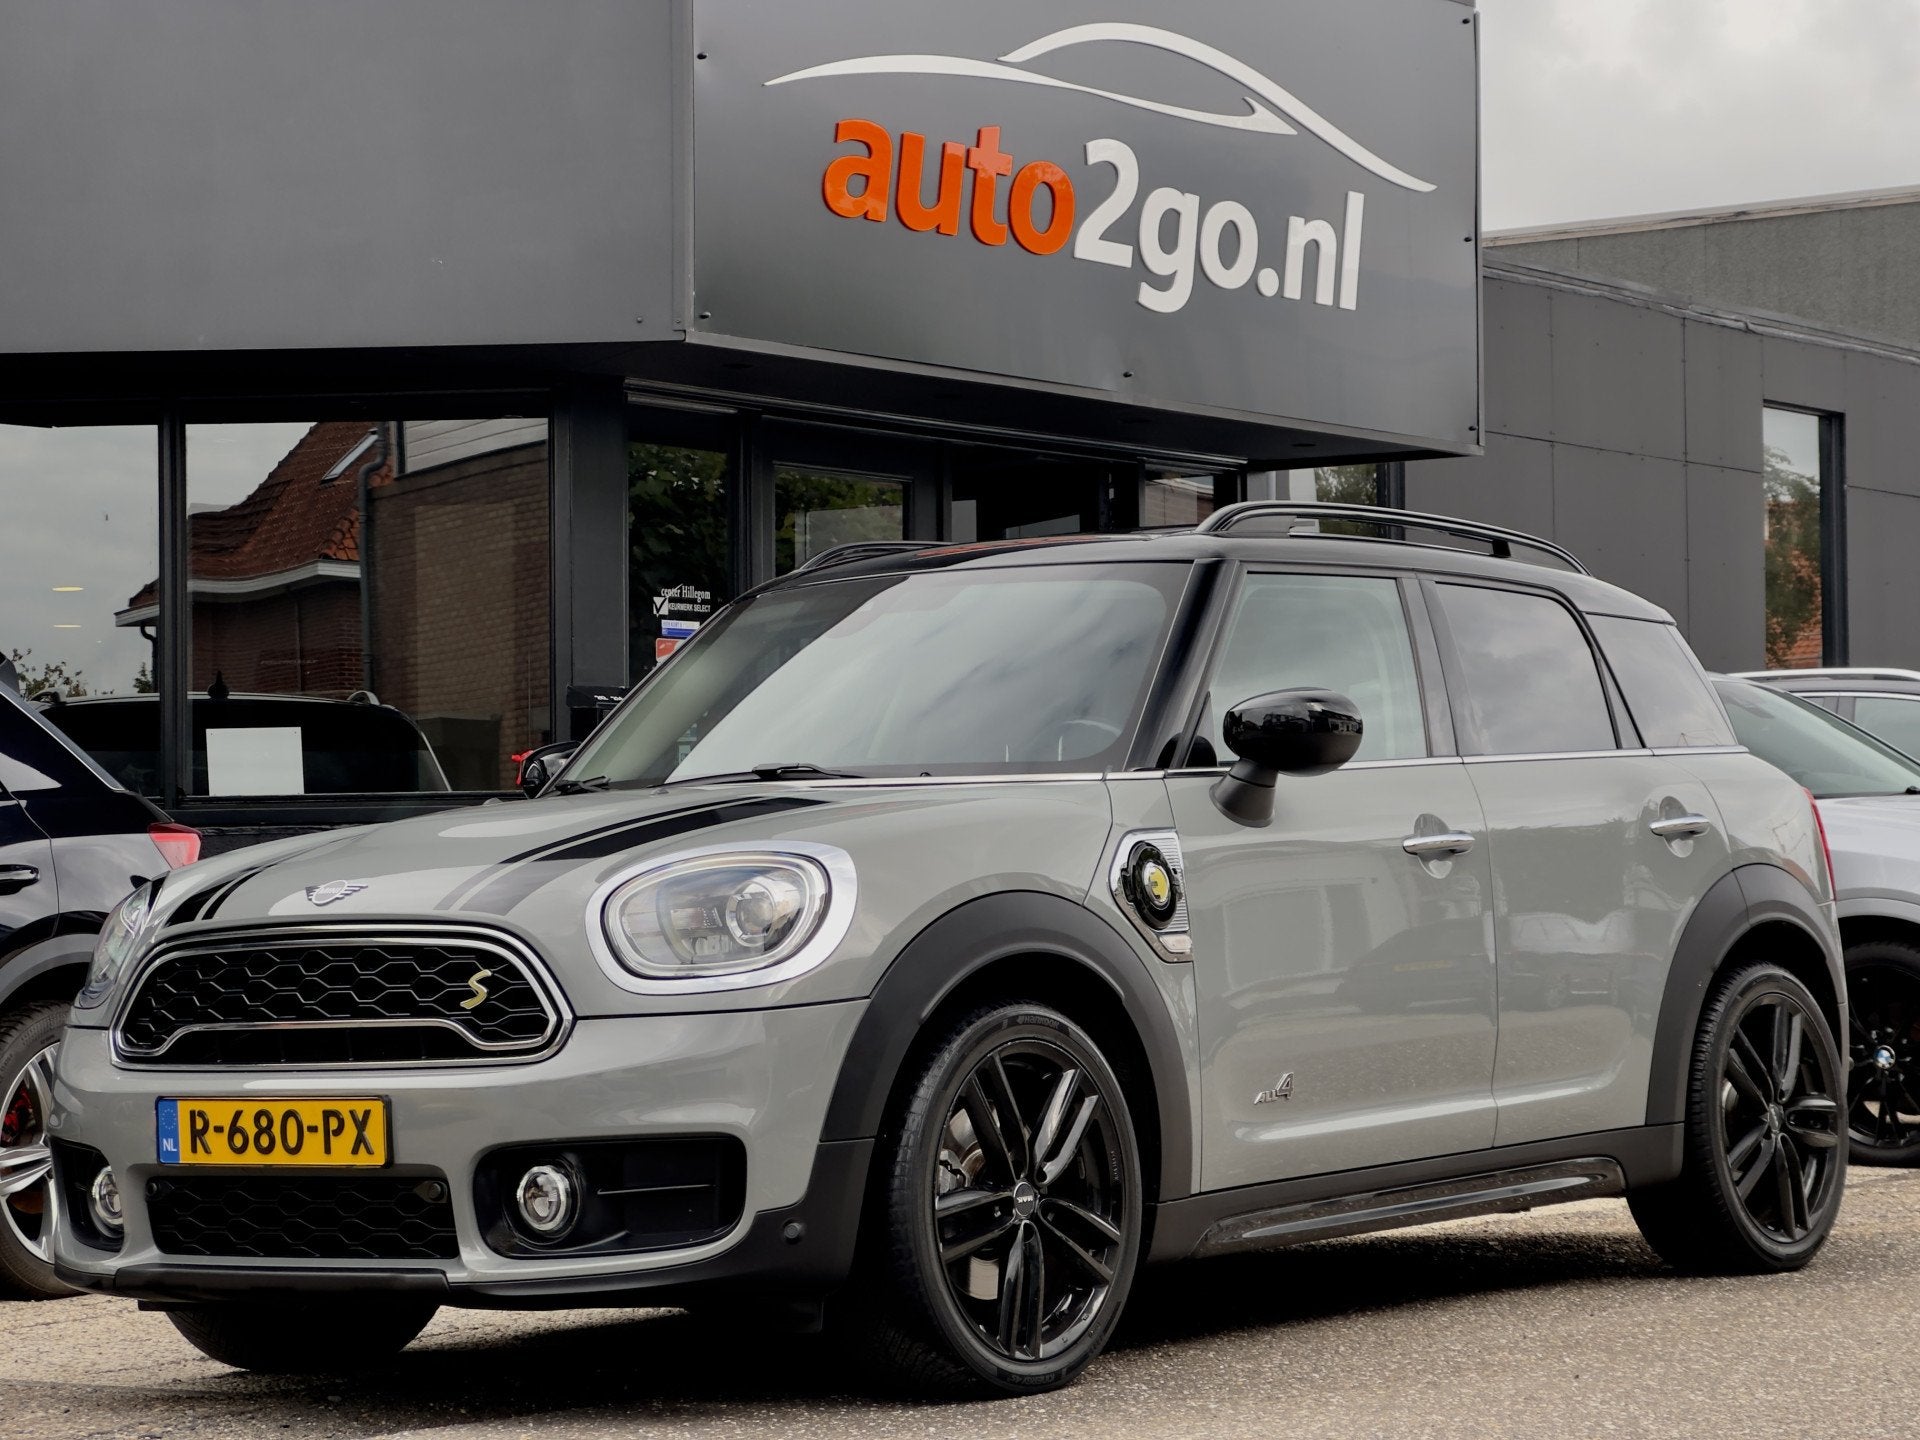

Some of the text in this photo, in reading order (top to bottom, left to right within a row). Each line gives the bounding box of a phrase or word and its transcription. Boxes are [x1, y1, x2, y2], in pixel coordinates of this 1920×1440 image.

[822, 118, 1364, 313] auto2go.nl
[682, 585, 711, 602] Hillegom
[694, 603, 711, 612] SELECT
[460, 969, 492, 1009] S
[163, 1138, 177, 1152] NL
[189, 1108, 375, 1156] R-680-PX
